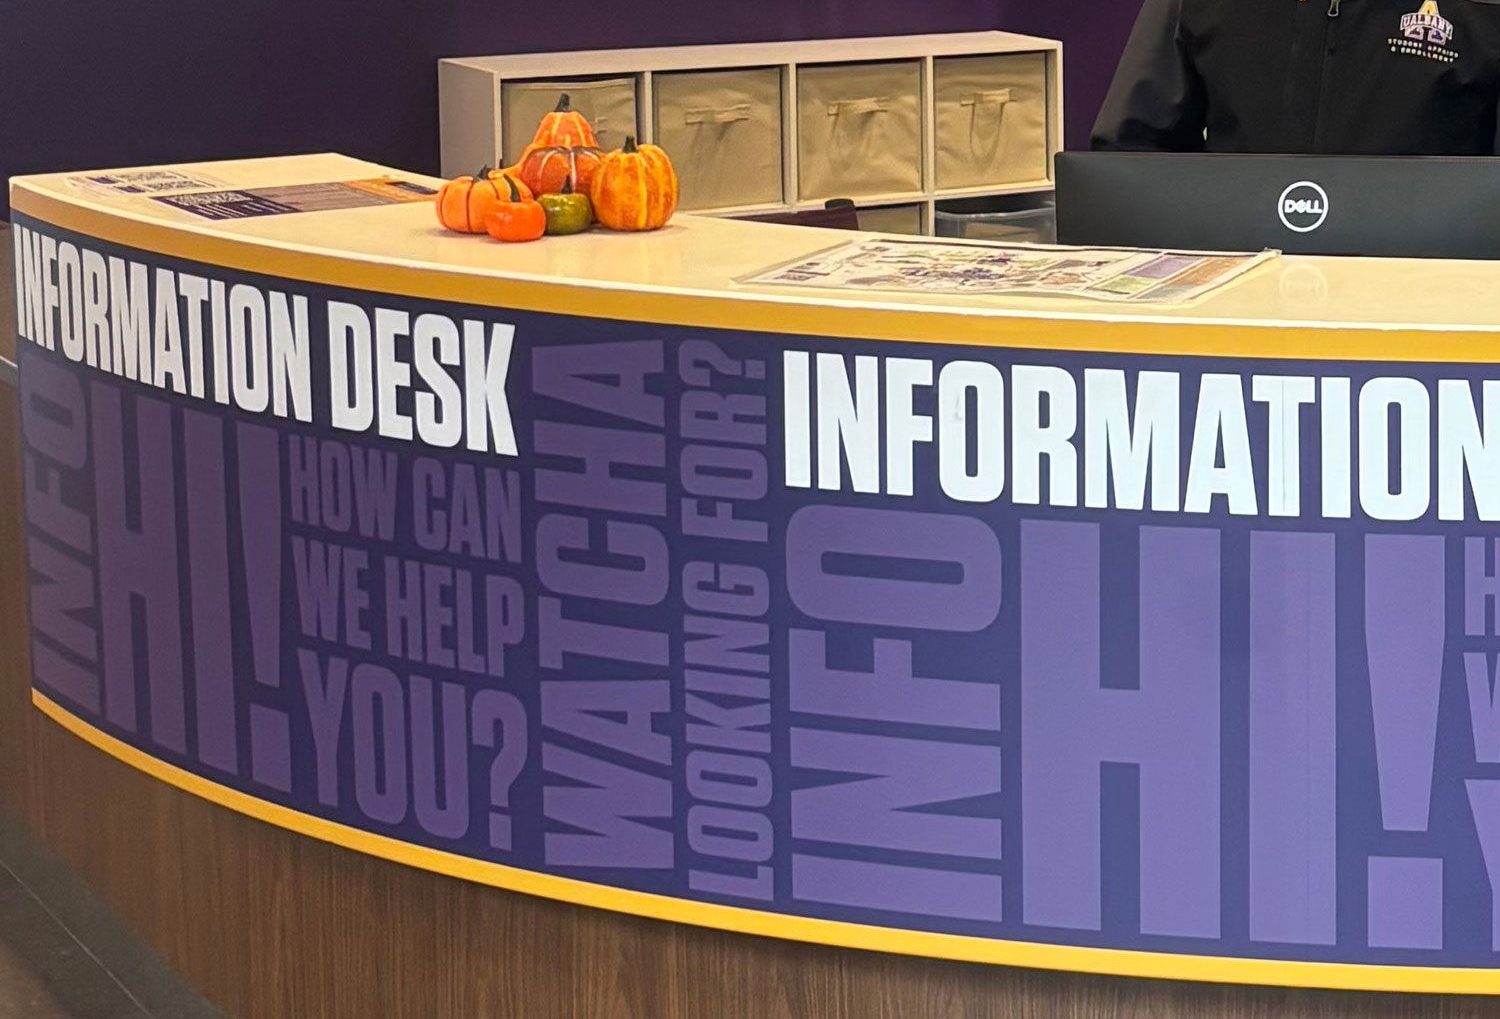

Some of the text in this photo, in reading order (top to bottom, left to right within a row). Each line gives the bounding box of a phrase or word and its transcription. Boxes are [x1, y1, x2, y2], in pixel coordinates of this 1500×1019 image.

[1388, 38, 1422, 49] STUDENT
[1401, 13, 1453, 40] UALBANY
[1284, 199, 1323, 214] DELL
[14, 223, 519, 457] INFORMATION DESK
[20, 356, 101, 726] INFO
[91, 379, 292, 793] HI!
[287, 433, 522, 563] HOW CAN
[291, 535, 525, 677] WE HELP
[531, 339, 675, 870] WATCHA
[678, 338, 775, 902] LOOKING FOR?
[785, 504, 1003, 923] INFO
[1020, 518, 1446, 950] HI!
[298, 646, 529, 852] YOU?
